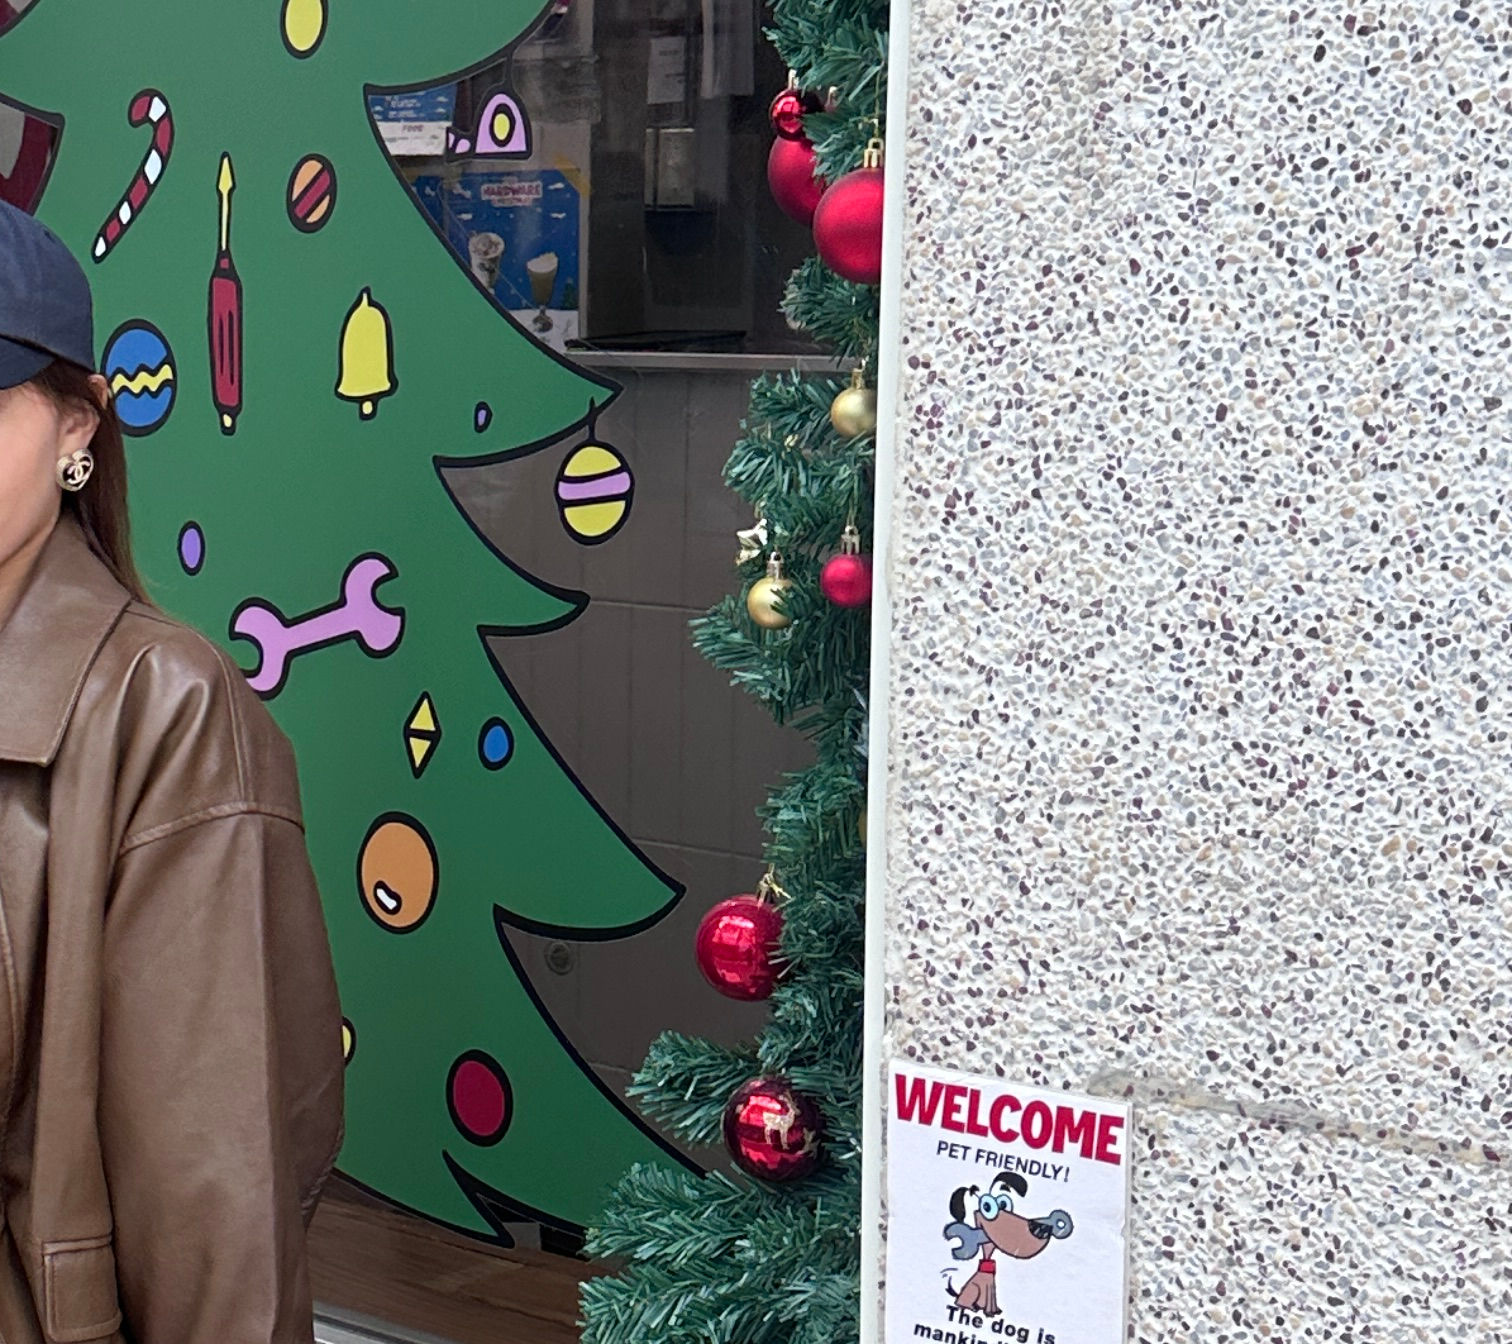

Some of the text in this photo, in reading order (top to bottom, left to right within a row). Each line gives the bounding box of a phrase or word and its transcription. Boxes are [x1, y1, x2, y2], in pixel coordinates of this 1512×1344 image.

[895, 1073, 1125, 1165] WELCOME
[936, 1140, 1070, 1183] PET FRIENDLY!
[946, 1305, 984, 1330] The
[991, 1316, 1029, 1344] dog
